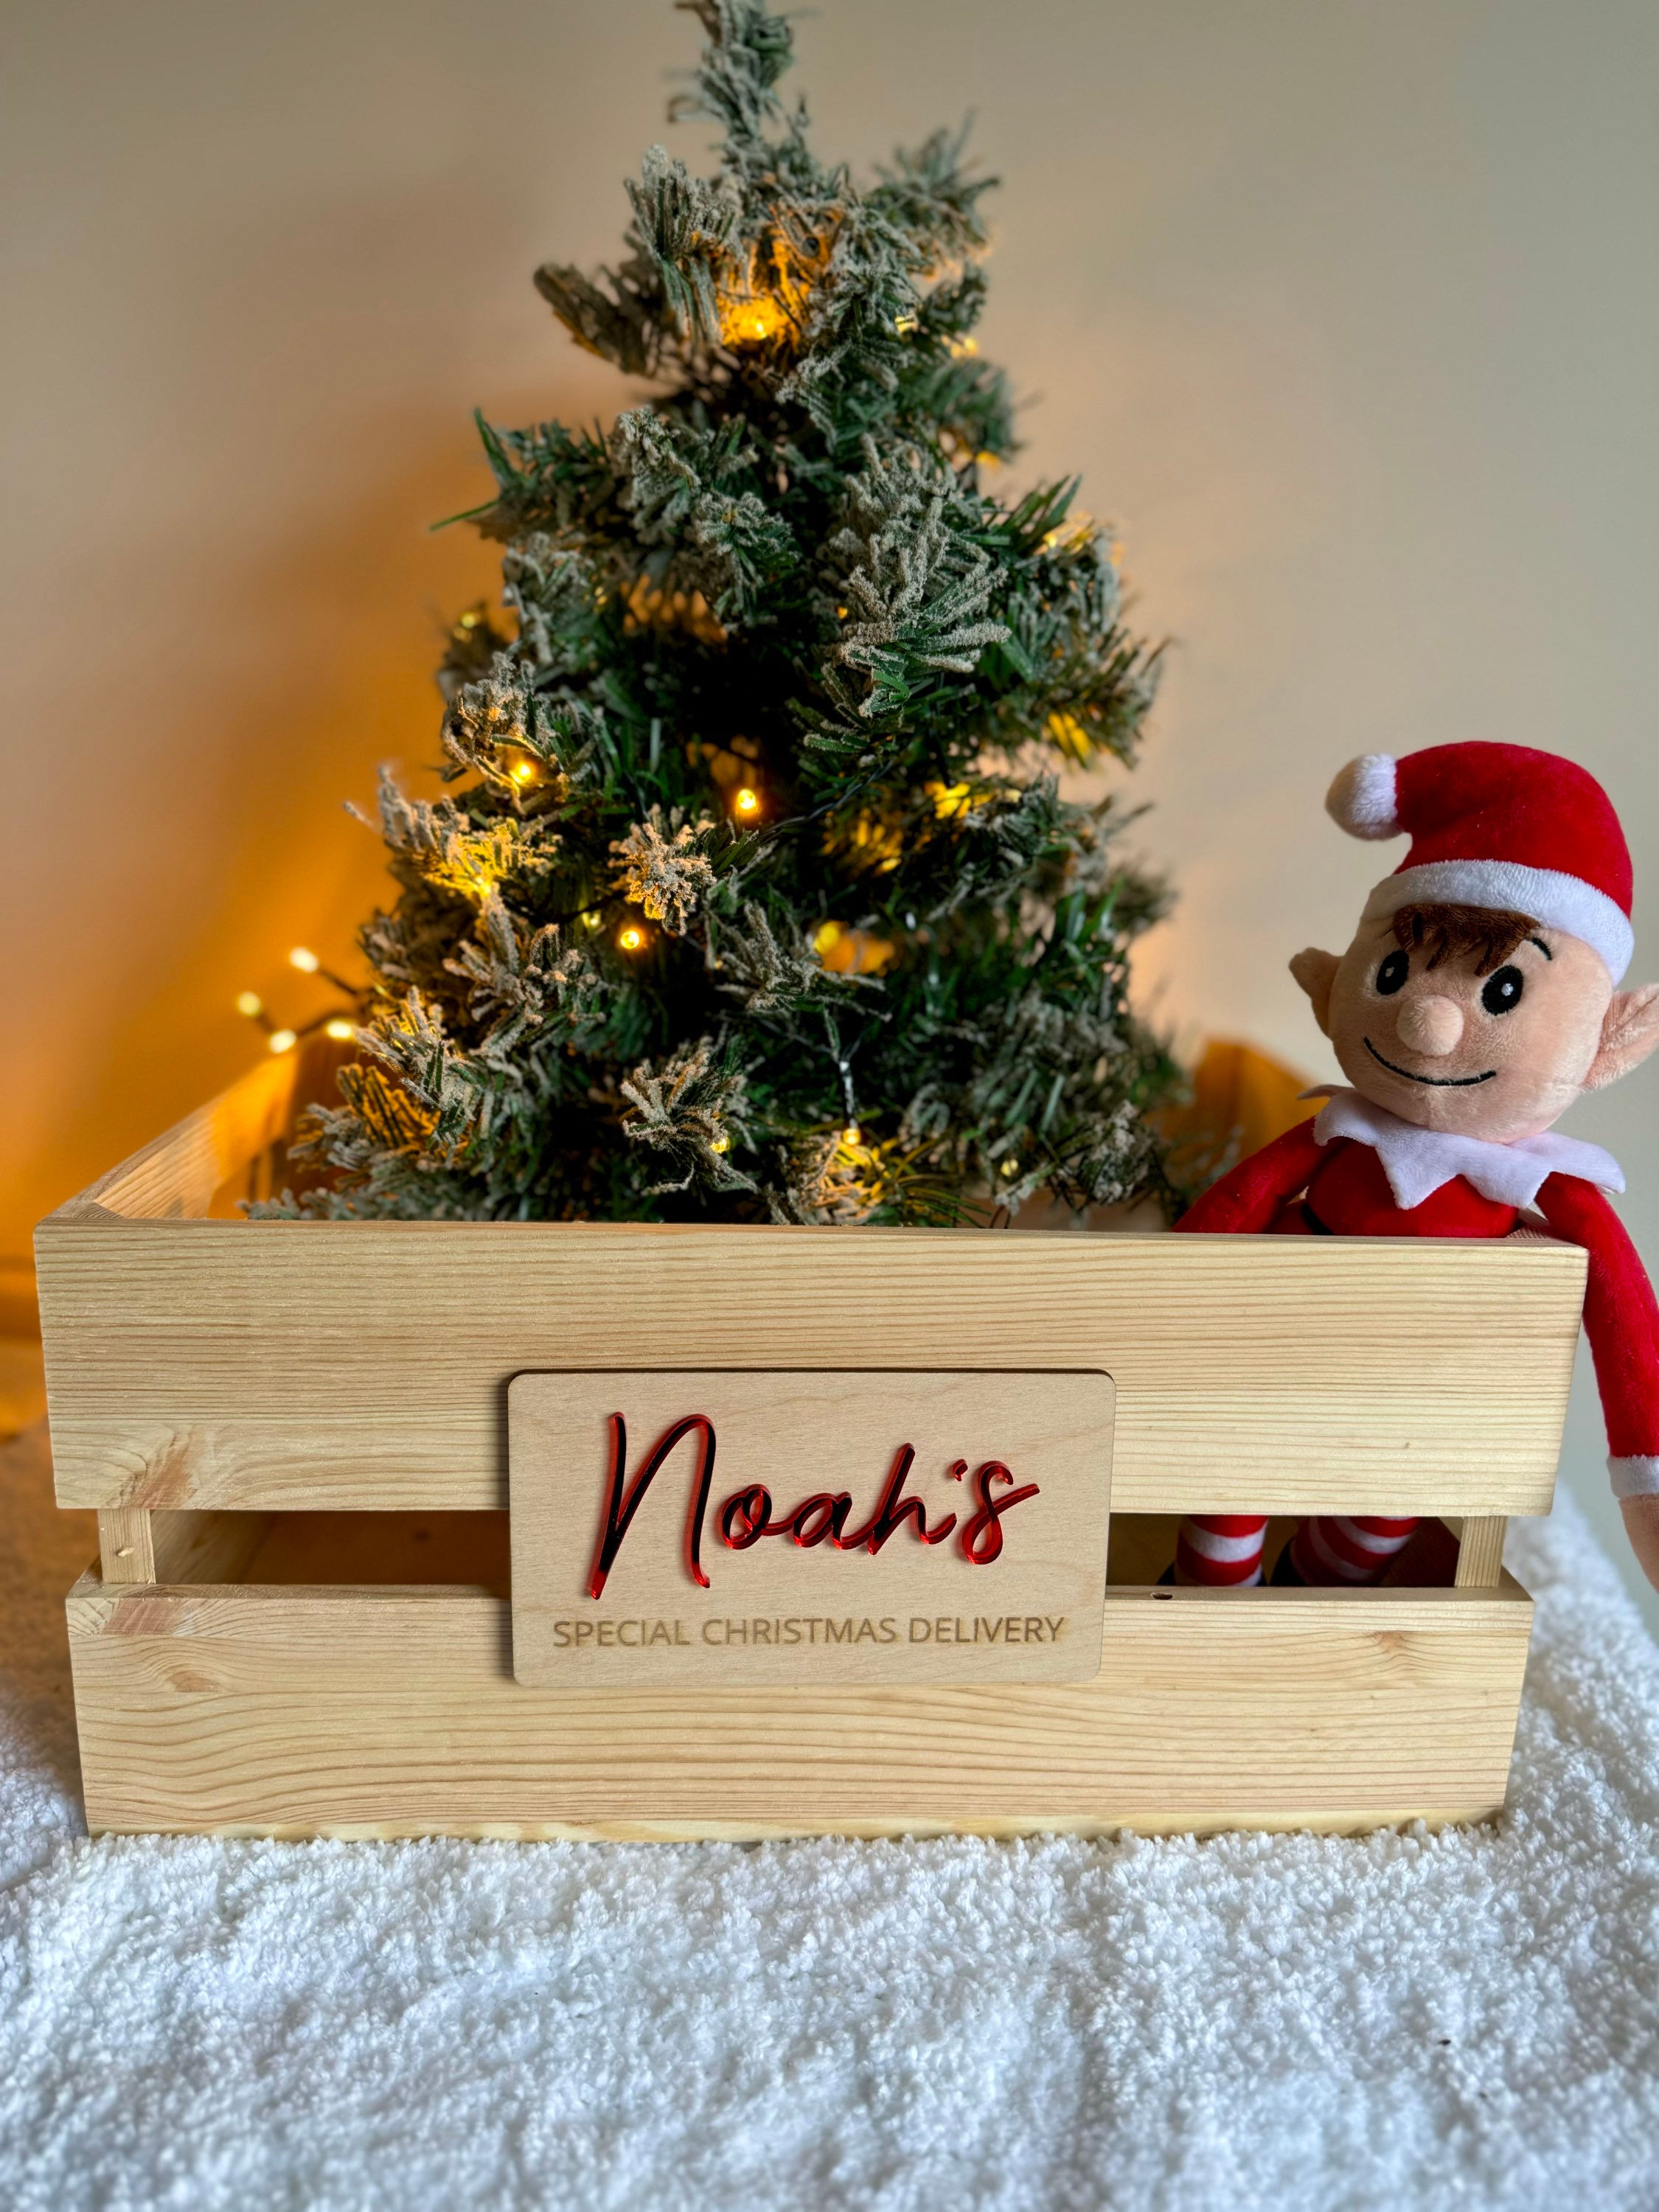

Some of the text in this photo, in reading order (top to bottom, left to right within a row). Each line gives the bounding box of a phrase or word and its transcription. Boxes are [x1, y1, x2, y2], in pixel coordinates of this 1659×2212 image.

[586, 1411, 1041, 1600] Noah's
[553, 1616, 1065, 1648] SPECIAL CHRISTMAS DELIVERY
